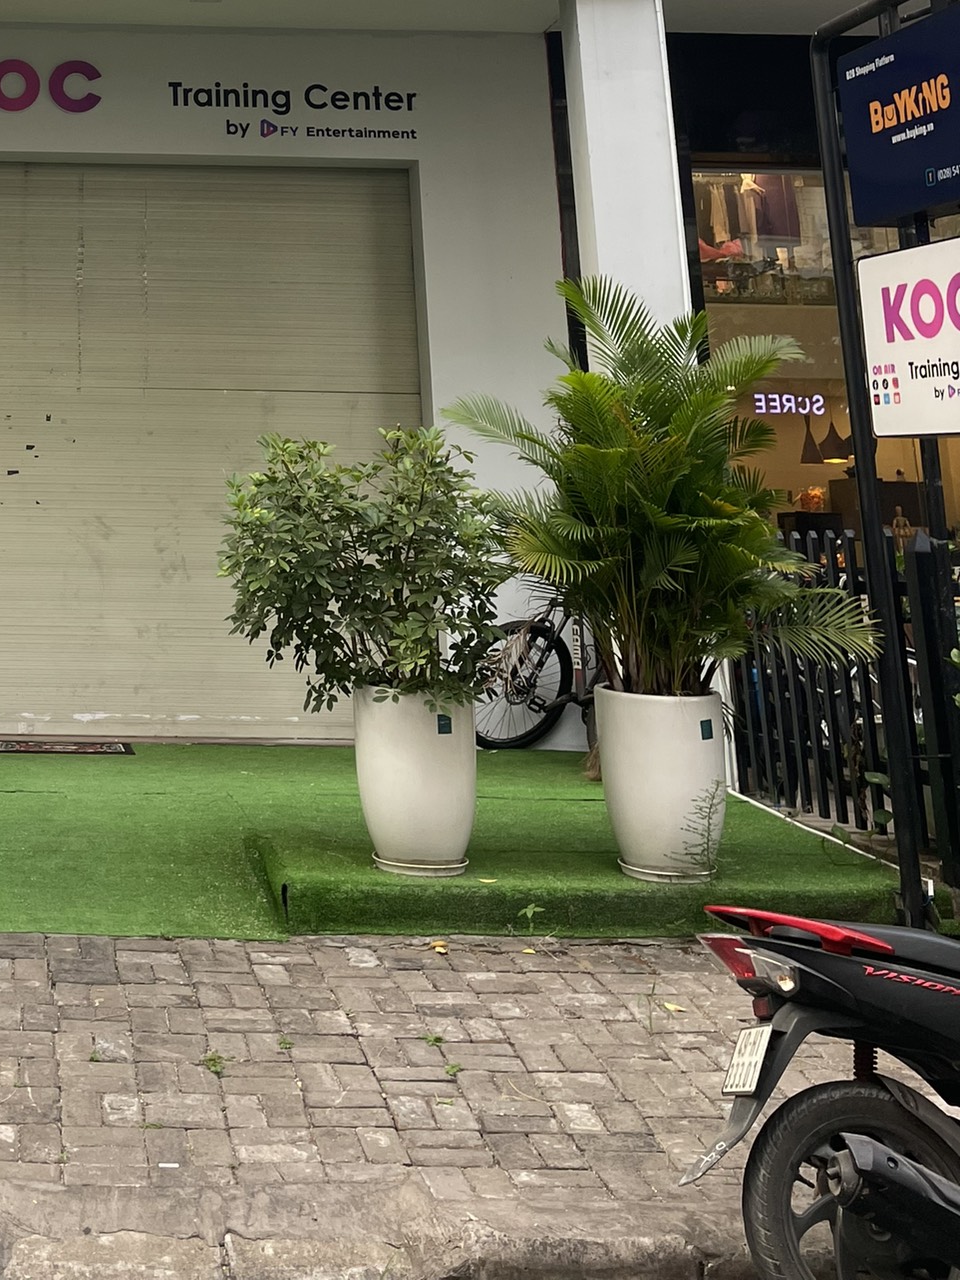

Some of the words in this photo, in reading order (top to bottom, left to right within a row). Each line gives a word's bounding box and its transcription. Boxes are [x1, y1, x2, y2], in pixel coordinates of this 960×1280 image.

[168, 82, 290, 115] Training
[304, 84, 417, 111] Center
[226, 119, 250, 138] by
[306, 127, 417, 140] Entertainment
[872, 365, 882, 375] ON
[908, 357, 960, 381] Training
[934, 387, 945, 400] by
